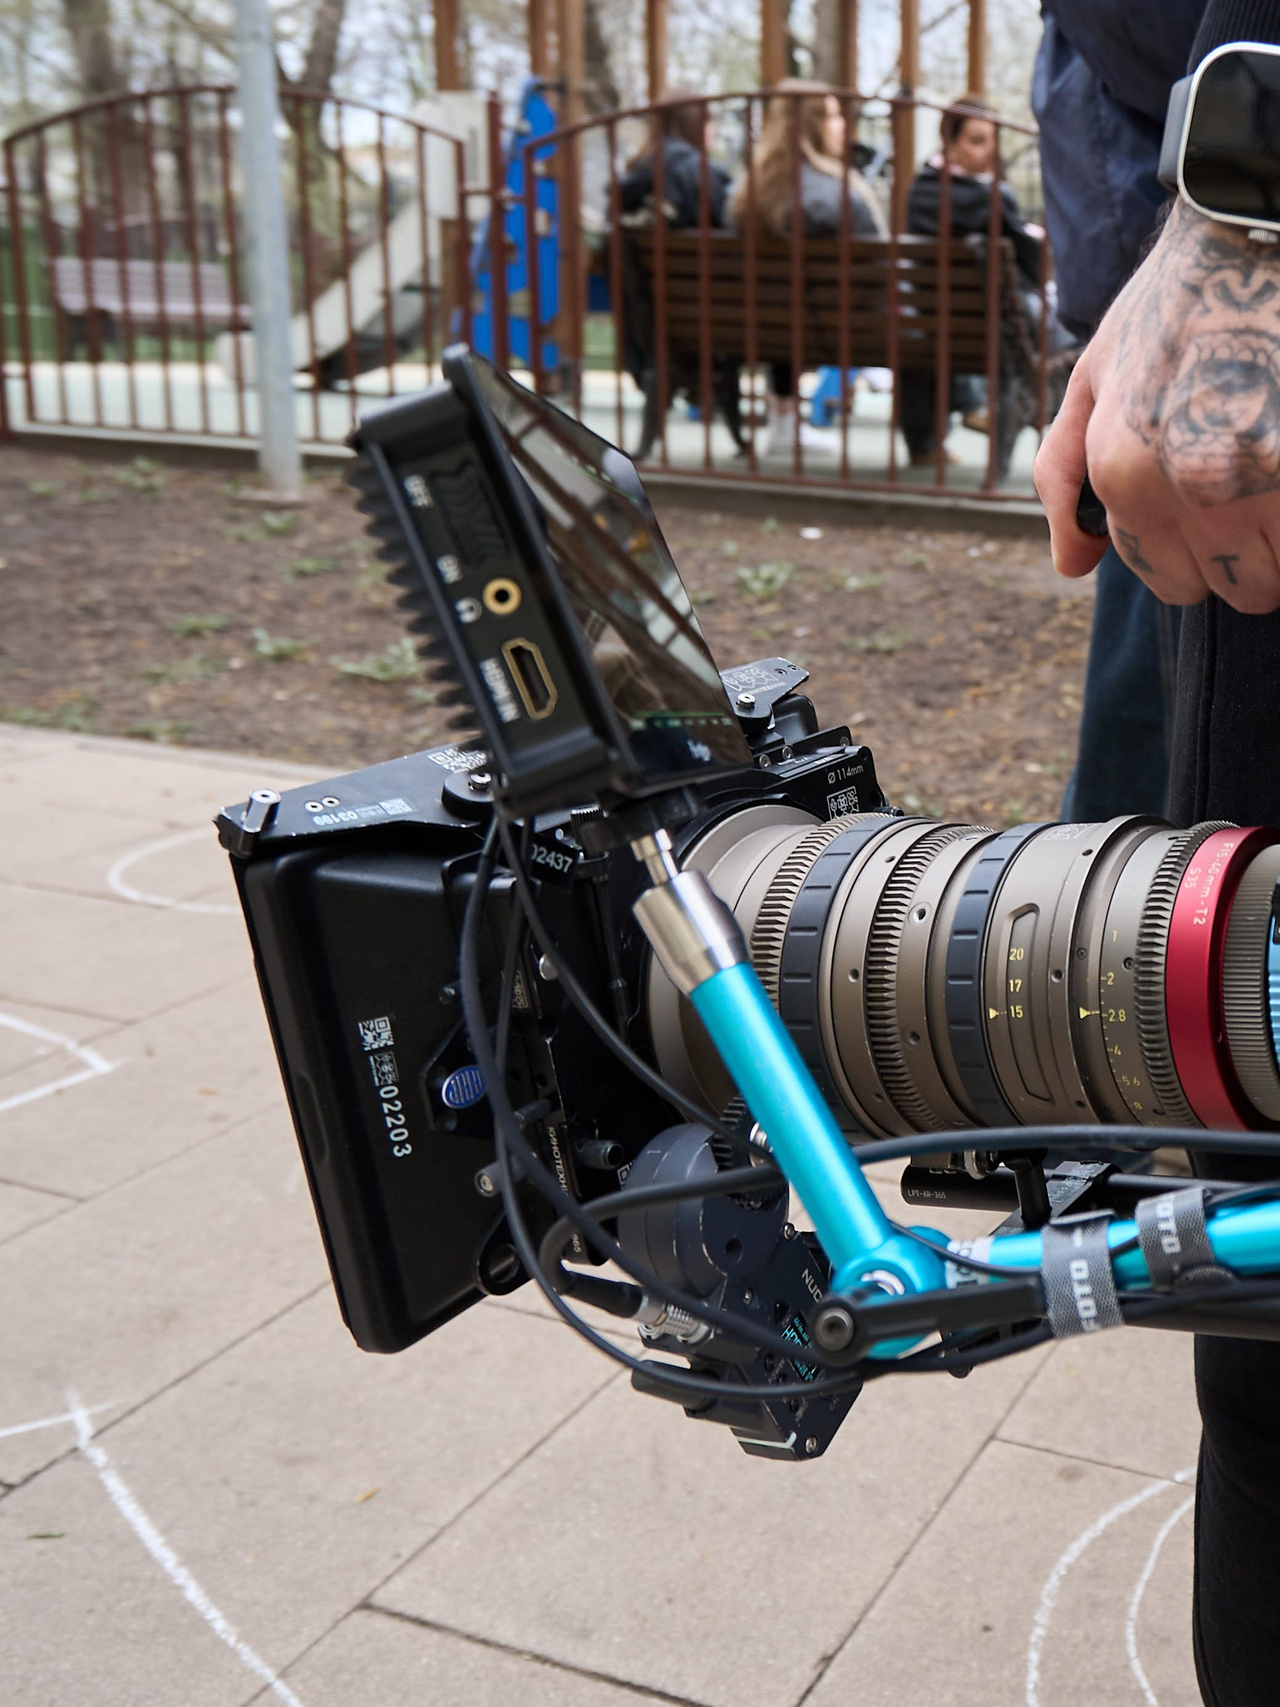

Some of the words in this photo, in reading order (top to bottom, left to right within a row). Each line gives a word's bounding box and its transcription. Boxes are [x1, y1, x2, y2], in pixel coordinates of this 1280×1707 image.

[1212, 554, 1241, 586] T
[837, 765, 864, 781] 114mm
[1009, 947, 1025, 961] 20
[1106, 971, 1115, 986] 2
[1009, 979, 1022, 993] 17
[1009, 1005, 1024, 1019] 15
[1108, 1008, 1127, 1022] 2.8
[379, 1085, 413, 1158] 02203
